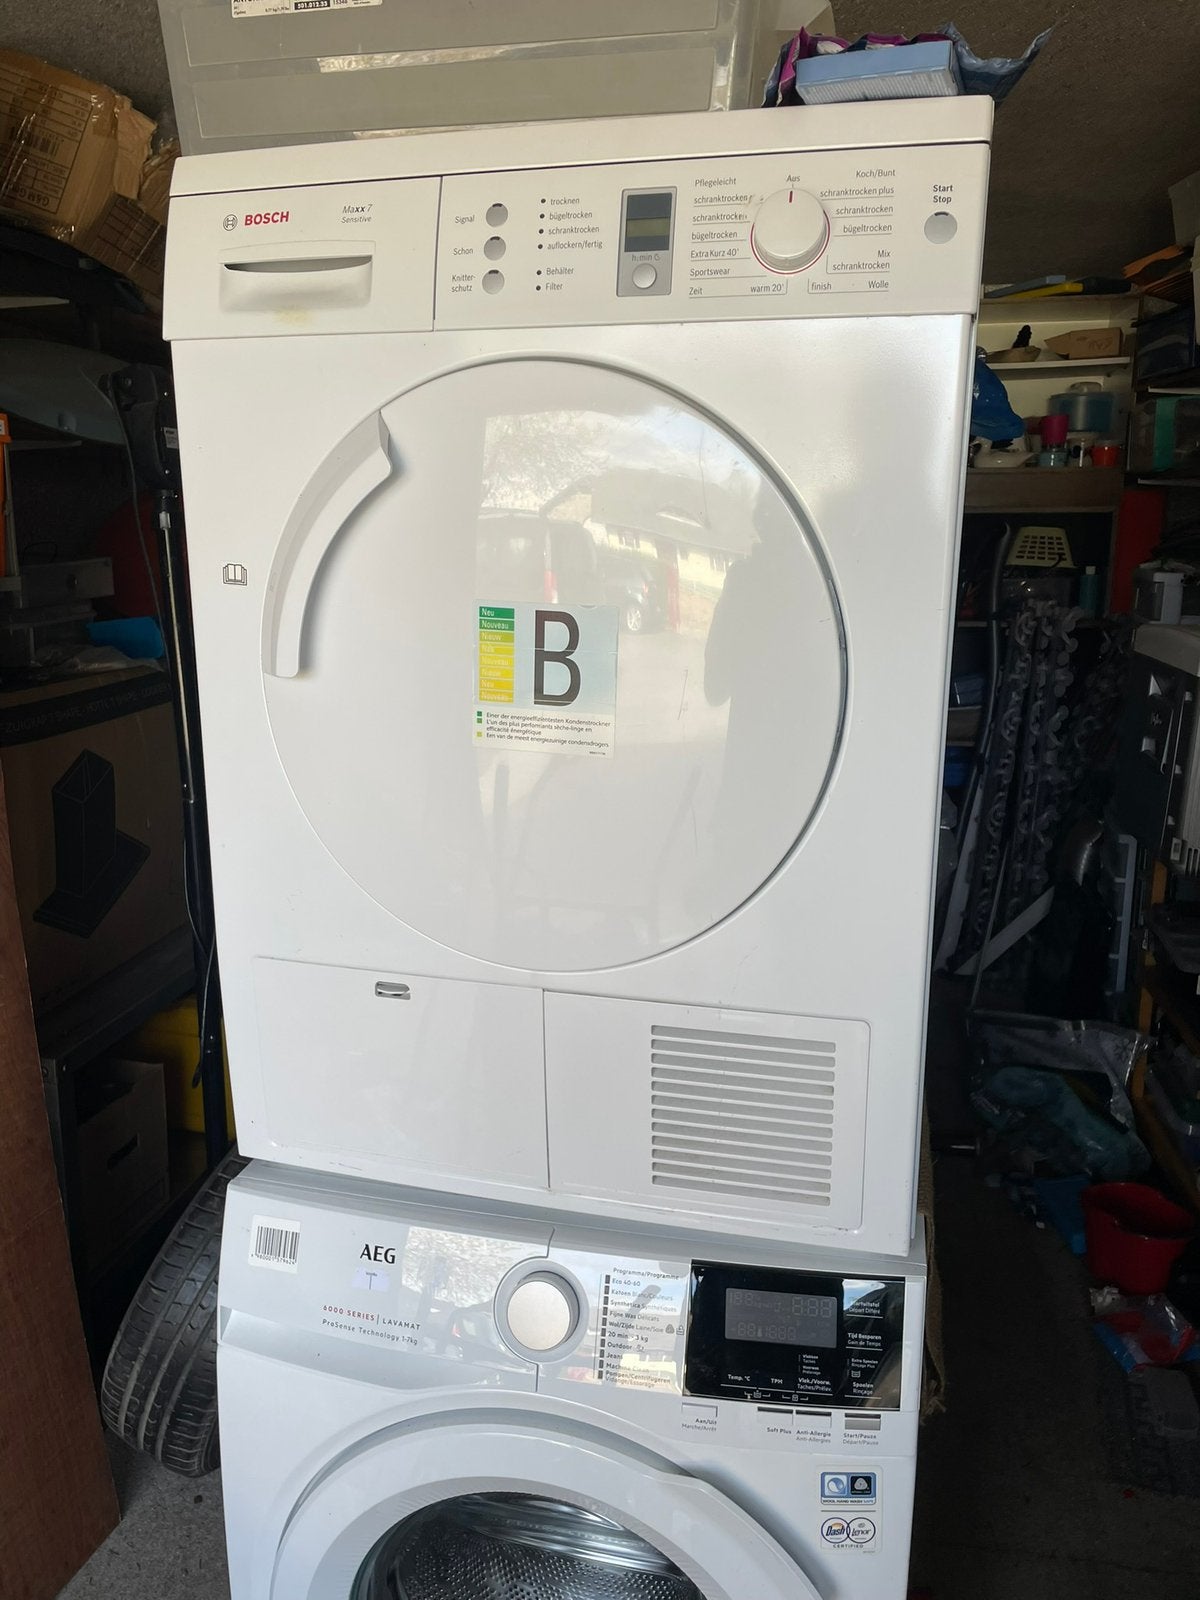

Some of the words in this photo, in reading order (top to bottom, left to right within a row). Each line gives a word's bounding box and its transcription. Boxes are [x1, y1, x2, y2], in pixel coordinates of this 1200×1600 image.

[786, 174, 801, 182] Aus
[855, 169, 896, 178] Koch/Bunt
[694, 178, 737, 188] Pflegeleicht
[819, 189, 878, 198] schranktrocken
[878, 187, 895, 196] plus
[933, 184, 953, 193] Start
[550, 197, 580, 207] trocknen
[693, 194, 748, 204] schranktrocken
[933, 195, 952, 204] Stop
[342, 205, 365, 214] Maxx
[366, 204, 373, 212] 7
[835, 206, 894, 215] schranktrocken
[244, 211, 290, 226] BOSCH
[341, 216, 372, 224] Sensitive
[455, 215, 475, 225] Signal
[549, 211, 593, 220] bügeltrocken
[548, 226, 600, 236] schranktrocken
[843, 224, 892, 234] bügeltrocken
[691, 230, 738, 241] bügeltrocken
[547, 240, 603, 251] auflockern/fertig
[453, 247, 474, 256] Schon
[690, 249, 708, 258] Extra
[709, 249, 726, 257] Kurz
[546, 267, 574, 275] Behälter
[832, 262, 890, 271] schranktrocken
[689, 268, 731, 277] Sportswear
[451, 274, 476, 283] Knitter-
[451, 284, 472, 293] schutz
[811, 281, 832, 290] finish
[868, 280, 889, 289] Wolle
[689, 287, 703, 295] Zeit
[750, 285, 771, 293] warm
[481, 608, 495, 617] Neu
[481, 620, 509, 630] Nouveau
[534, 609, 581, 707] B
[565, 719, 611, 727] Kondenstrockner
[360, 1243, 397, 1265] AEG
[613, 1267, 680, 1280] Programma/Programme
[322, 1305, 344, 1315] 6000
[346, 1309, 375, 1321] SERIES
[382, 1318, 421, 1331] LAVAMAT
[609, 1310, 624, 1320] Fijne
[322, 1318, 356, 1333] ProSense
[358, 1326, 400, 1342] Technology
[401, 1335, 418, 1345] 1-7kg
[641, 1335, 649, 1343] kg
[847, 1332, 858, 1340] Tijd
[858, 1333, 882, 1341] Besparen
[607, 1341, 633, 1349] Outdoor
[728, 1374, 744, 1382] Temp.
[852, 1381, 874, 1389] Spoelen
[852, 1388, 874, 1396] Rinçage
[694, 1418, 718, 1426] Aan/Uit
[779, 1427, 792, 1435] Plus
[796, 1429, 832, 1438] Anti-Allergie
[826, 1524, 846, 1537] Dash
[851, 1528, 871, 1537] Lenor
